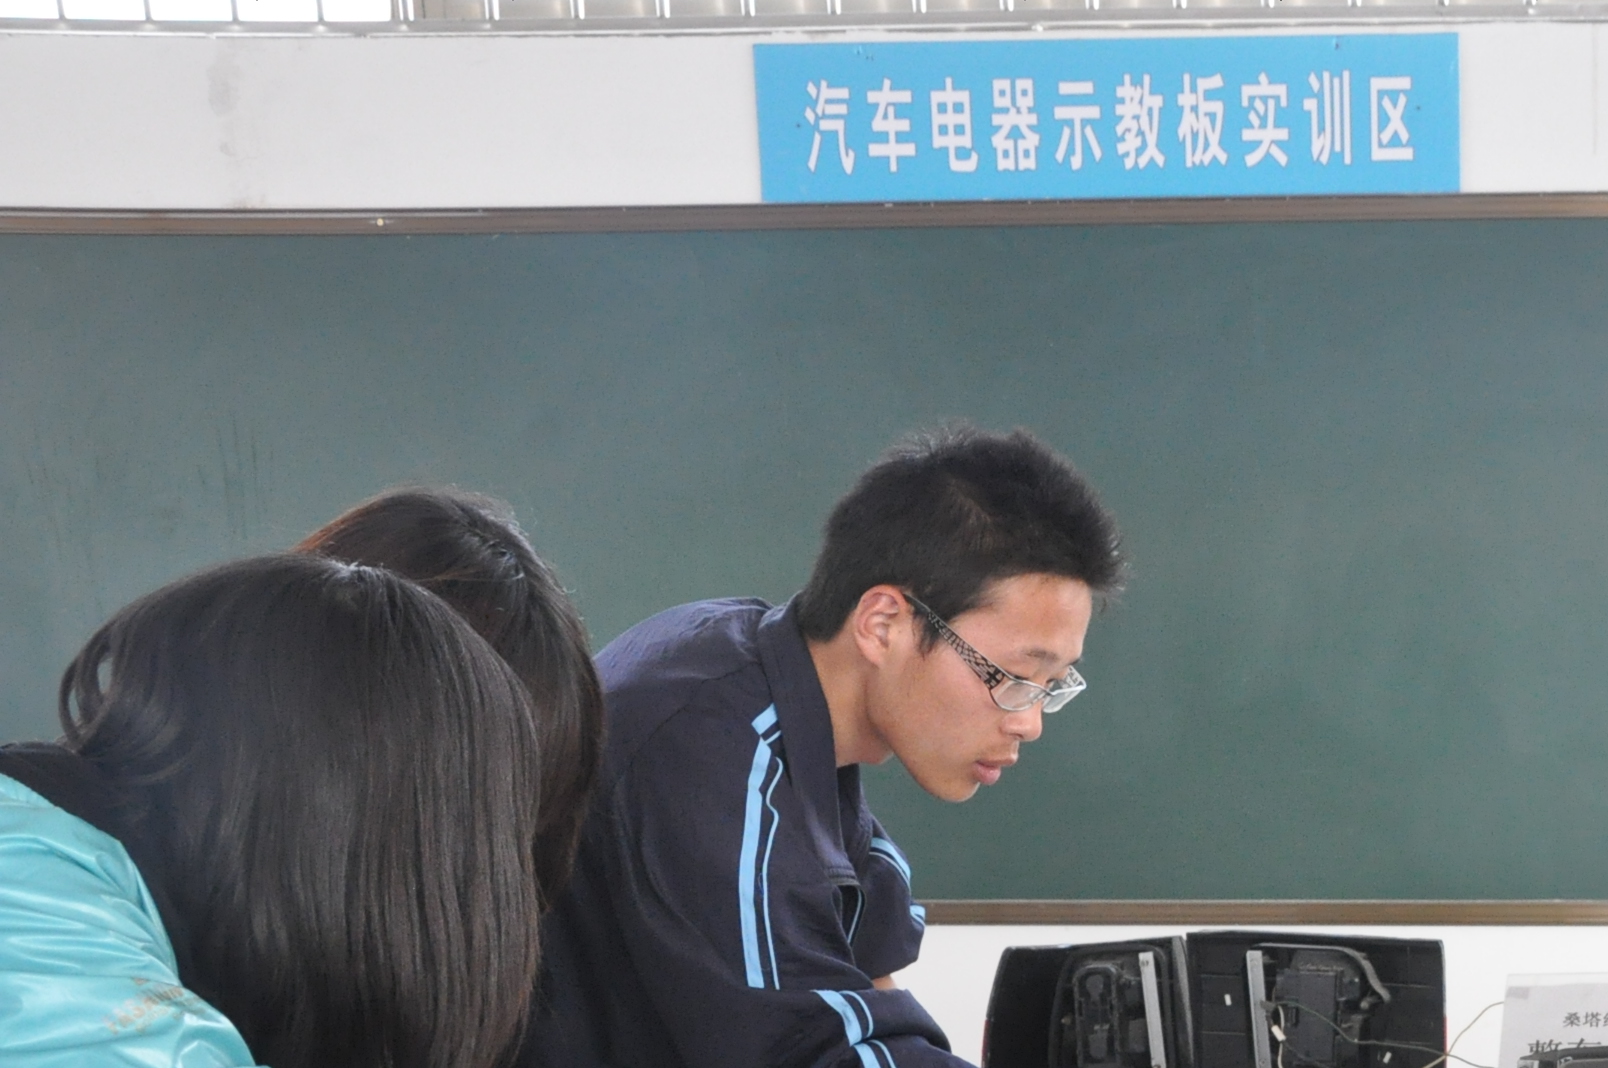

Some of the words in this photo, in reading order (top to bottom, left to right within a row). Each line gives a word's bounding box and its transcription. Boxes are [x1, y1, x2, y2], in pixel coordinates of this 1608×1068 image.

[804, 70, 1415, 176] 汽车电器示教板实训区
